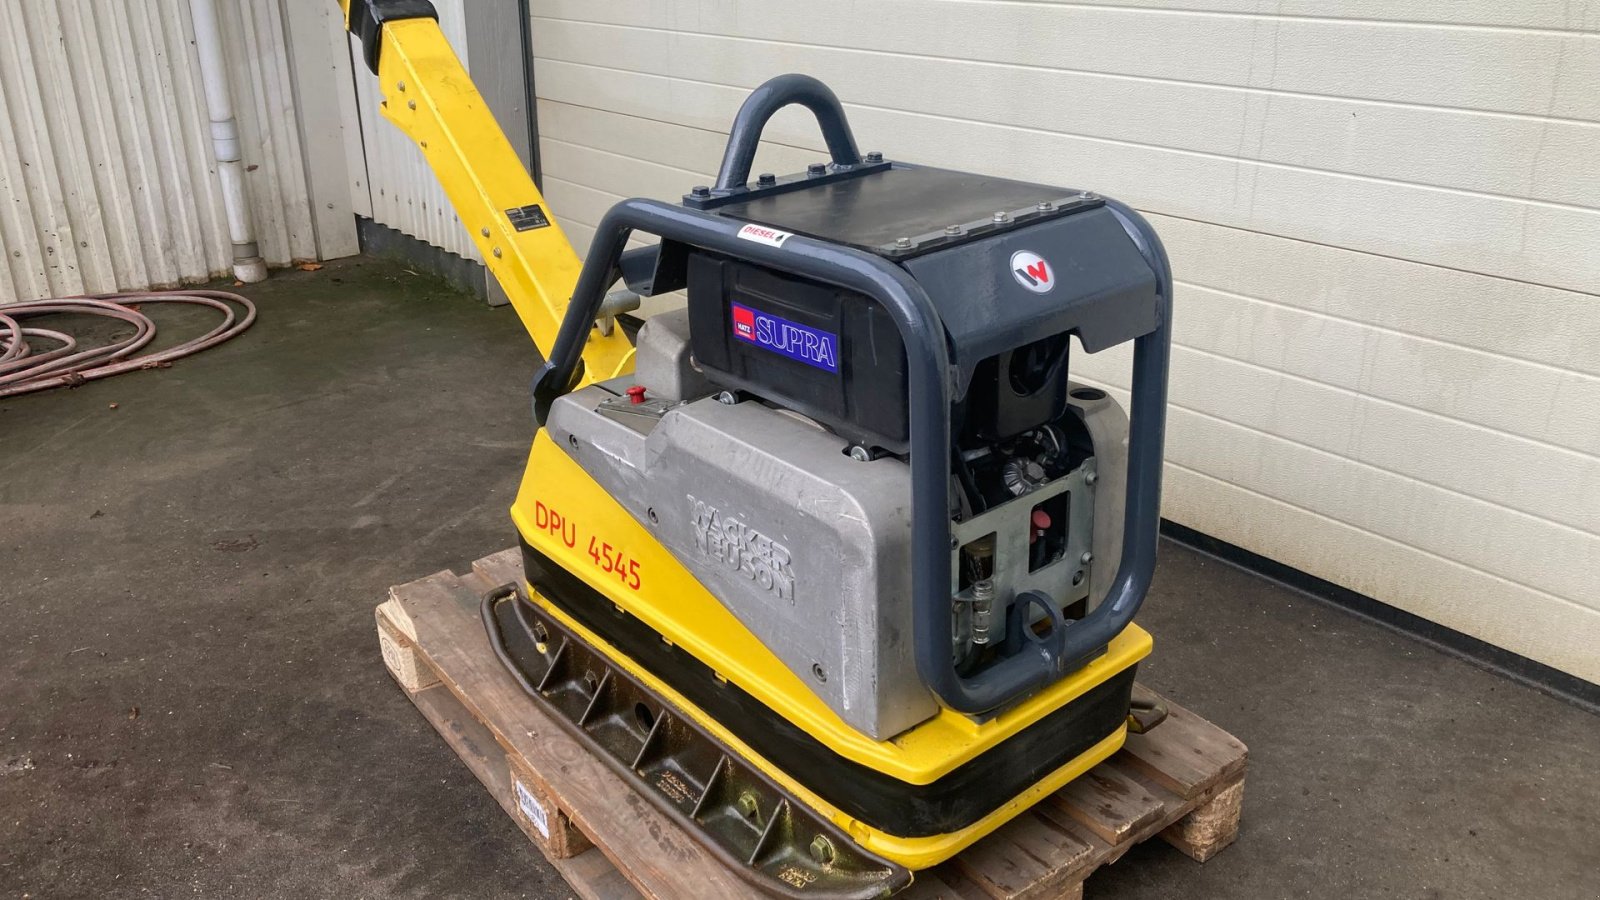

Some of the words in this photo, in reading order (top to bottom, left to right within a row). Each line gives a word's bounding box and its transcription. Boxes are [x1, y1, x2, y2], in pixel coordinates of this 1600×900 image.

[744, 227, 775, 239] DIESEL
[737, 322, 751, 333] HATZ
[756, 317, 835, 367] SUPRA
[535, 501, 576, 548] DPU
[588, 536, 641, 590] 4545
[687, 494, 791, 572] WACKER
[691, 521, 796, 606] NEUSON
